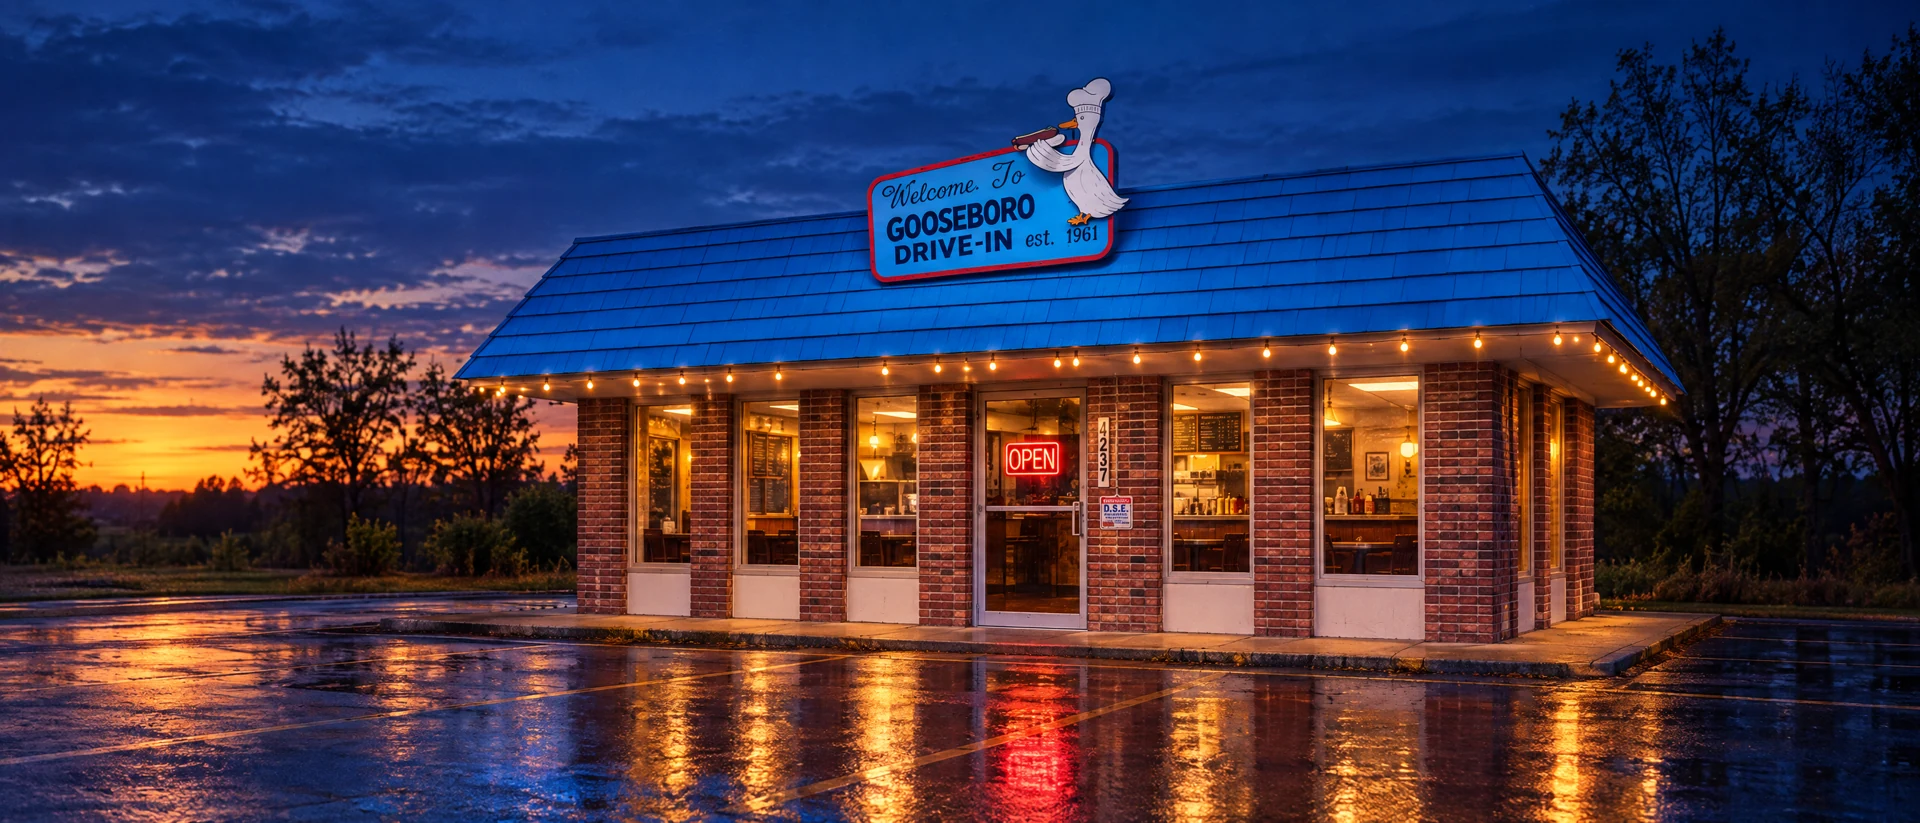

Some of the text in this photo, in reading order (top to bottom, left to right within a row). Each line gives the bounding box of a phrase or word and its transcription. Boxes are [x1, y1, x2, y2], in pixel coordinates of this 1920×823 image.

[991, 160, 1026, 189] To
[886, 193, 1036, 243] GOOSEBORO
[895, 225, 1098, 265] DRIVE-IN est. 1961
[1009, 447, 1055, 470] OPEN
[1099, 421, 1108, 482] 4237
[1103, 504, 1129, 513] D.S.E.
